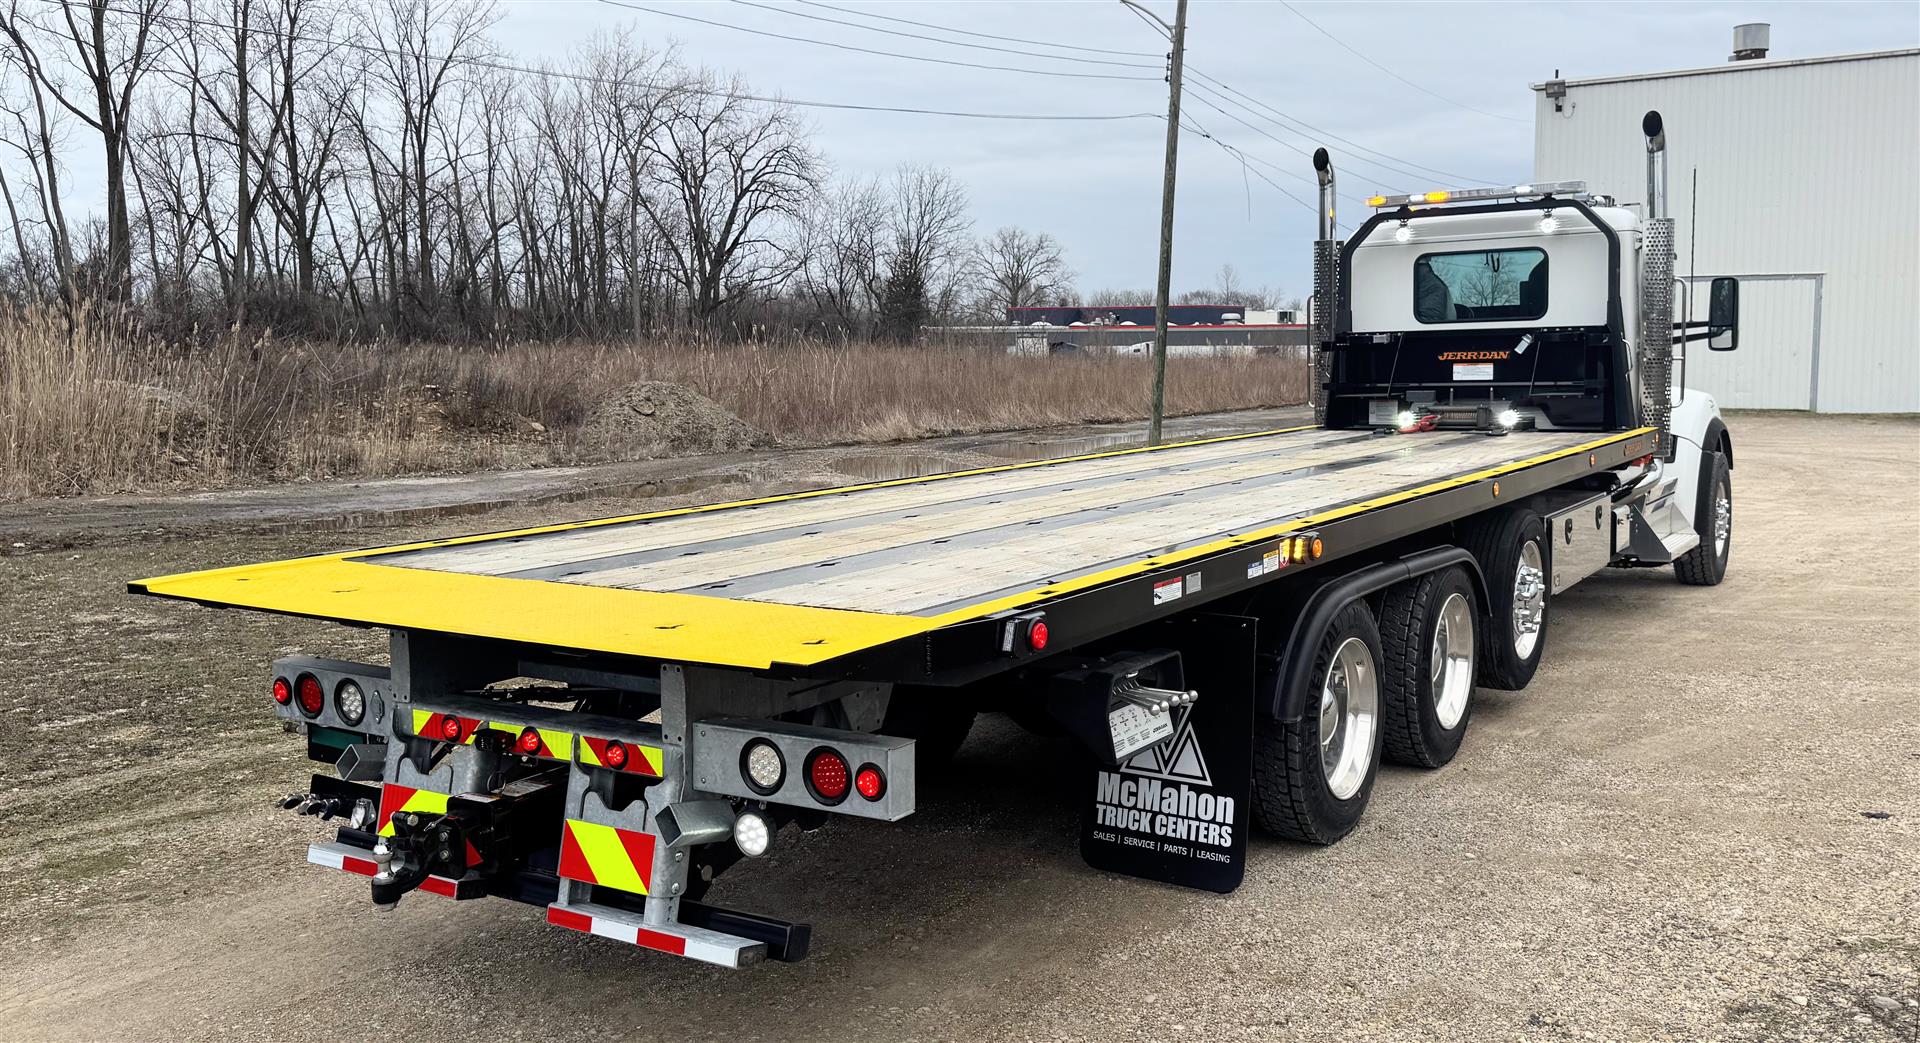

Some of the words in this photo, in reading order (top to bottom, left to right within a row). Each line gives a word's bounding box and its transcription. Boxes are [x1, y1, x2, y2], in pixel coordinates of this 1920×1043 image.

[1096, 770, 1235, 825] McMahon
[1093, 830, 1116, 842] SALES
[1123, 836, 1155, 850] SERVICE
[1163, 843, 1188, 856] PARTS
[1196, 849, 1231, 864] LEASING
[1096, 803, 1153, 834] TRUCK
[1154, 814, 1233, 848] CENTERS
